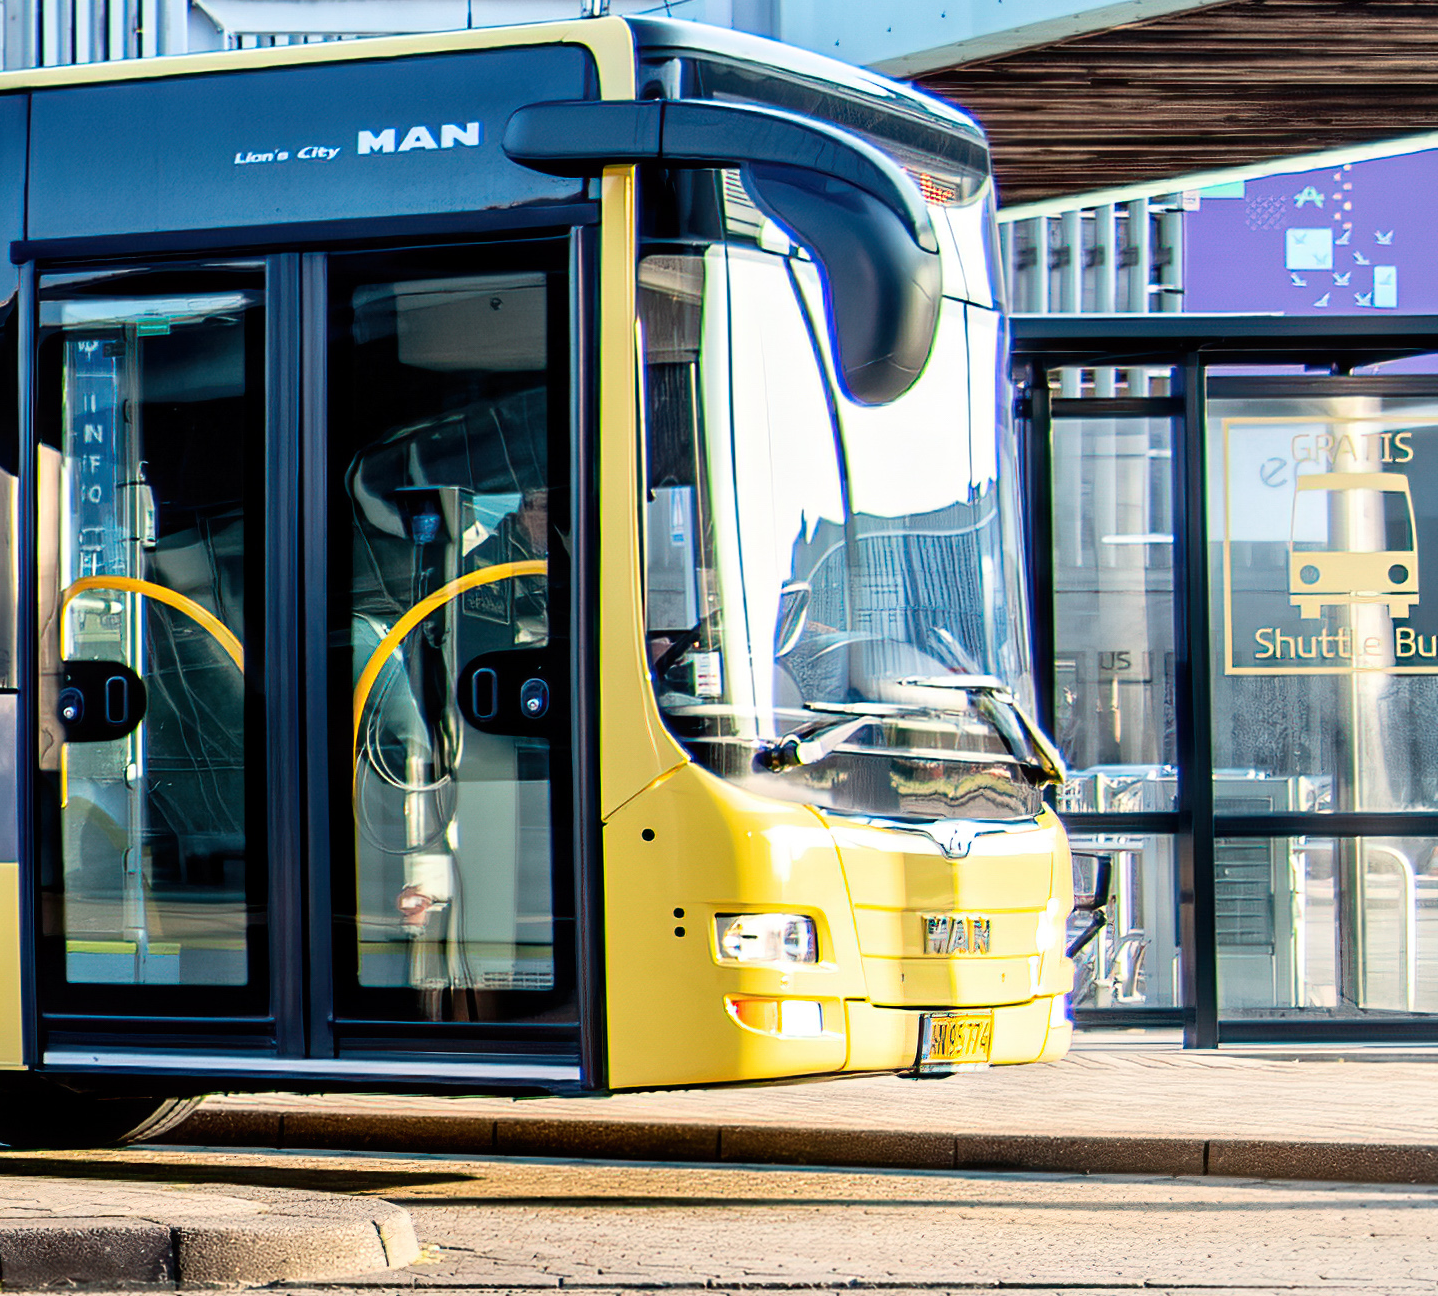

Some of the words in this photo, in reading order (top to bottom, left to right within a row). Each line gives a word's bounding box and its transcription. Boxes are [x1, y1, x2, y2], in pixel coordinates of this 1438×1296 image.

[296, 146, 341, 161] City
[357, 121, 480, 155] MAN
[1255, 627, 1384, 659] Shuttle
[1395, 627, 1438, 658] Bu
